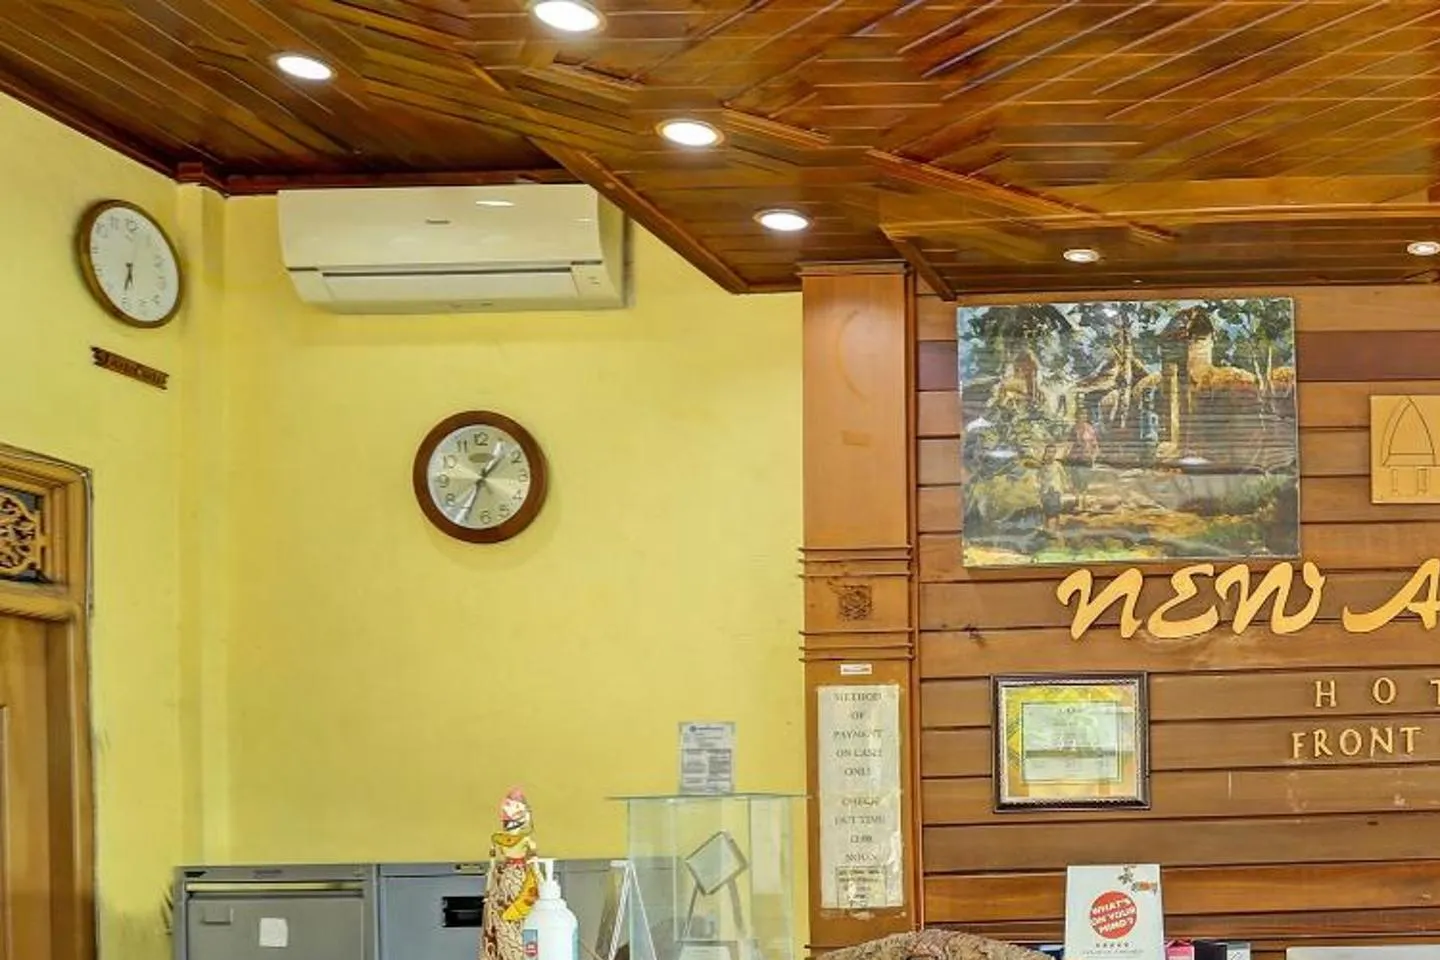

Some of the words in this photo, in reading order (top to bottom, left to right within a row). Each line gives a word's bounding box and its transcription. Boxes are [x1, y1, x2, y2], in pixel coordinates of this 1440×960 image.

[474, 432, 489, 446] 12
[457, 440, 468, 453] 11
[511, 450, 522, 463] 2
[439, 475, 450, 488] 9
[481, 510, 492, 524] 6
[1056, 562, 1326, 641] NEW
[1292, 726, 1424, 759] FRONT
